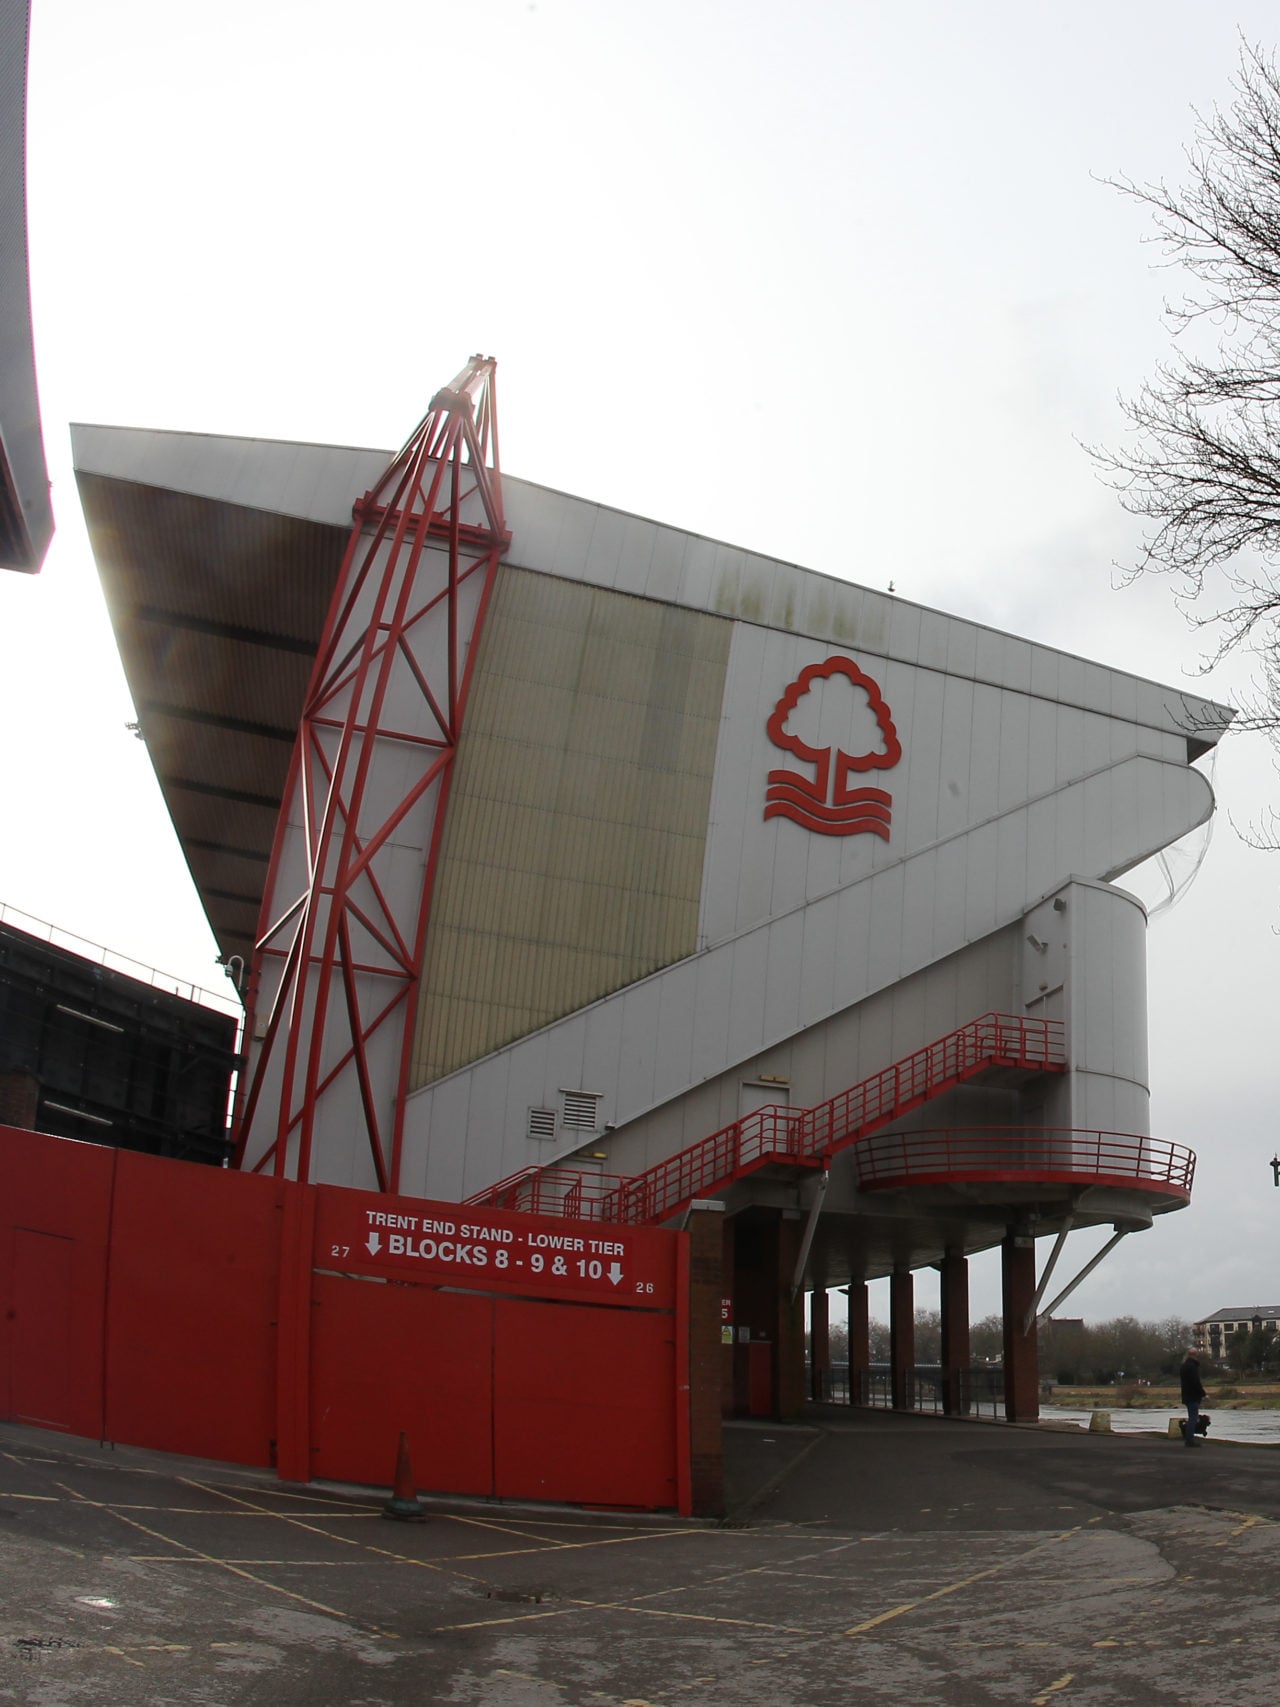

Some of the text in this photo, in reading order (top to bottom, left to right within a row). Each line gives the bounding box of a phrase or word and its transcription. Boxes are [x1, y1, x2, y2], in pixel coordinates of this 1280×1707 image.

[366, 1210, 418, 1231] TRENT
[422, 1219, 456, 1236] END
[460, 1224, 514, 1243] STAND
[528, 1233, 584, 1252] LOWER
[588, 1240, 625, 1256] TIER
[331, 1245, 351, 1258] 27
[388, 1234, 488, 1266] BLOCKS
[495, 1249, 509, 1269] 8
[531, 1253, 545, 1273] 9
[551, 1255, 568, 1276] &
[576, 1259, 602, 1280] 10
[636, 1282, 655, 1294] 26
